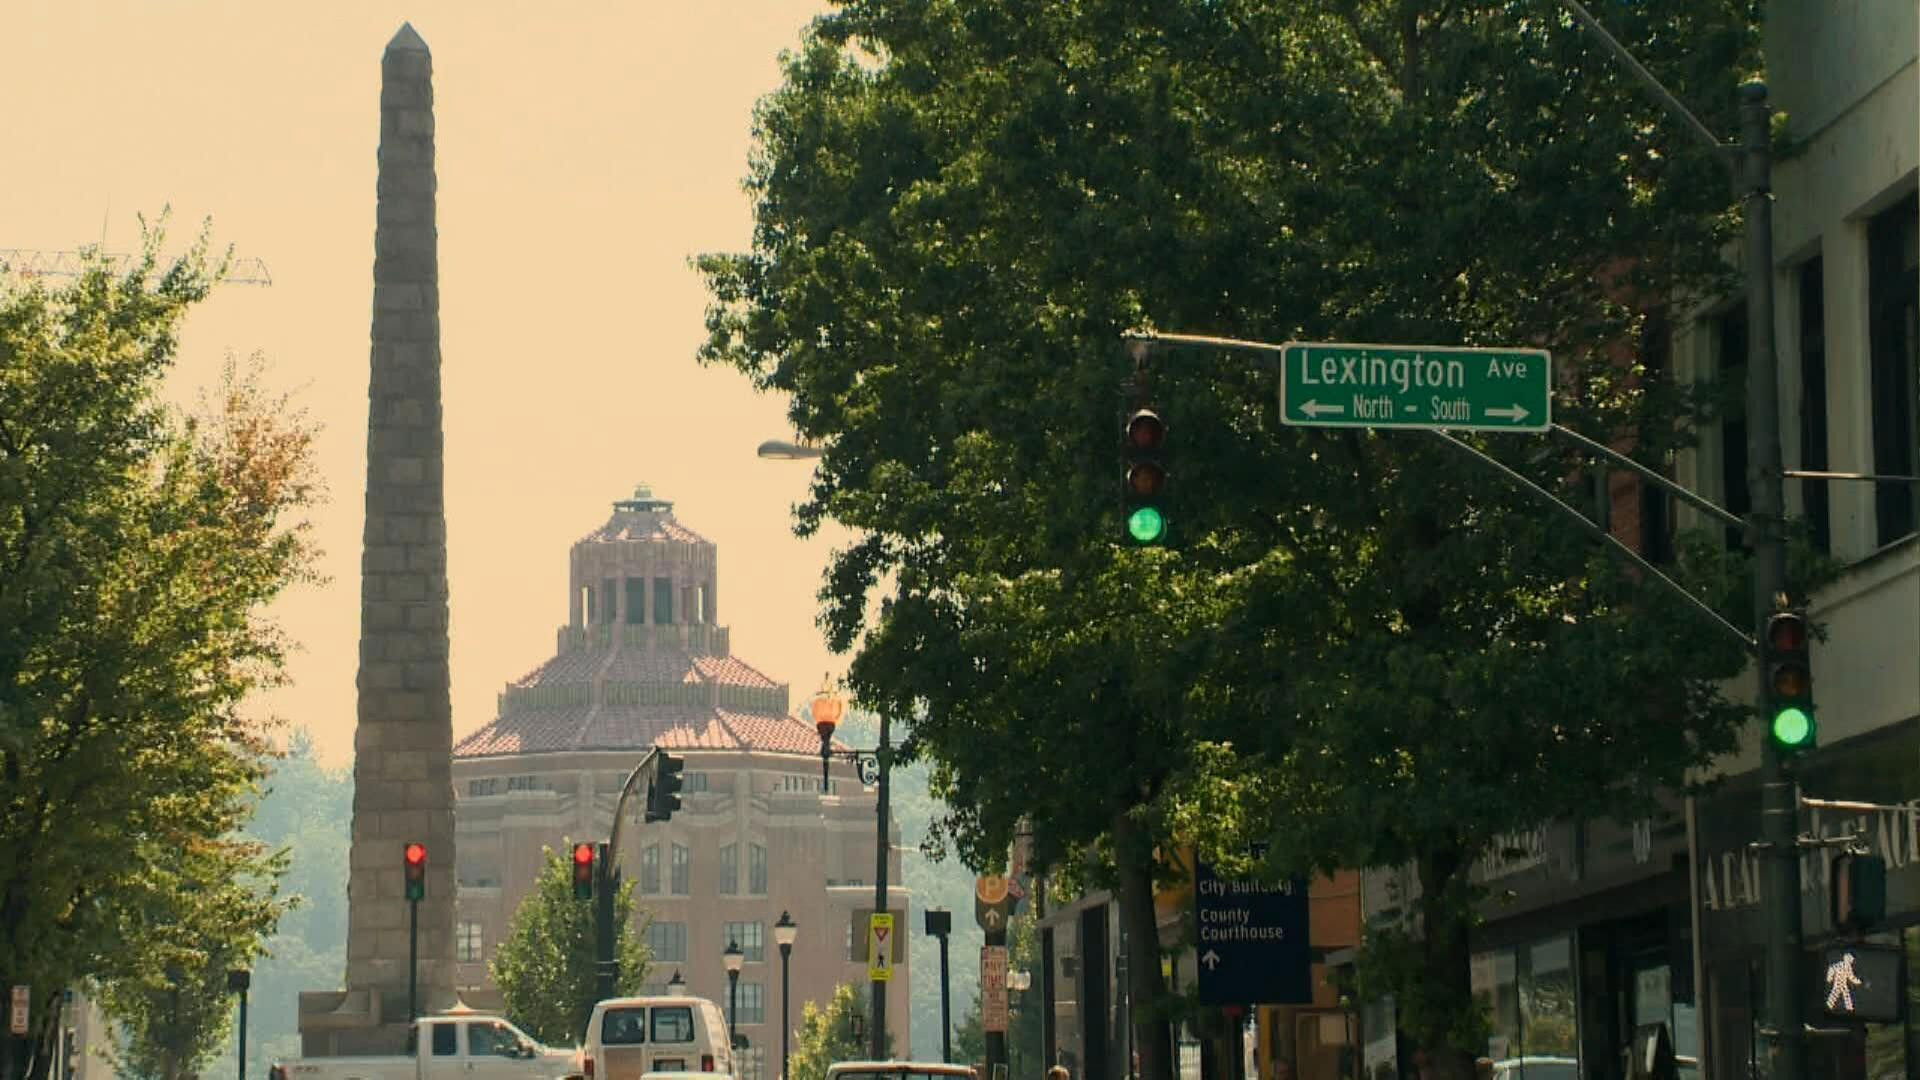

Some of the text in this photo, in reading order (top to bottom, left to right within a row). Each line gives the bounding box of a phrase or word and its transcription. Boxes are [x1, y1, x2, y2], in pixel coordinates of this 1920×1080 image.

[1301, 350, 1528, 394] Lexington Ave
[1353, 394, 1393, 419] North
[1431, 396, 1470, 421] South
[1200, 880, 1293, 897] City Builg
[1200, 908, 1251, 925] County
[1201, 925, 1284, 941] Courthouse
